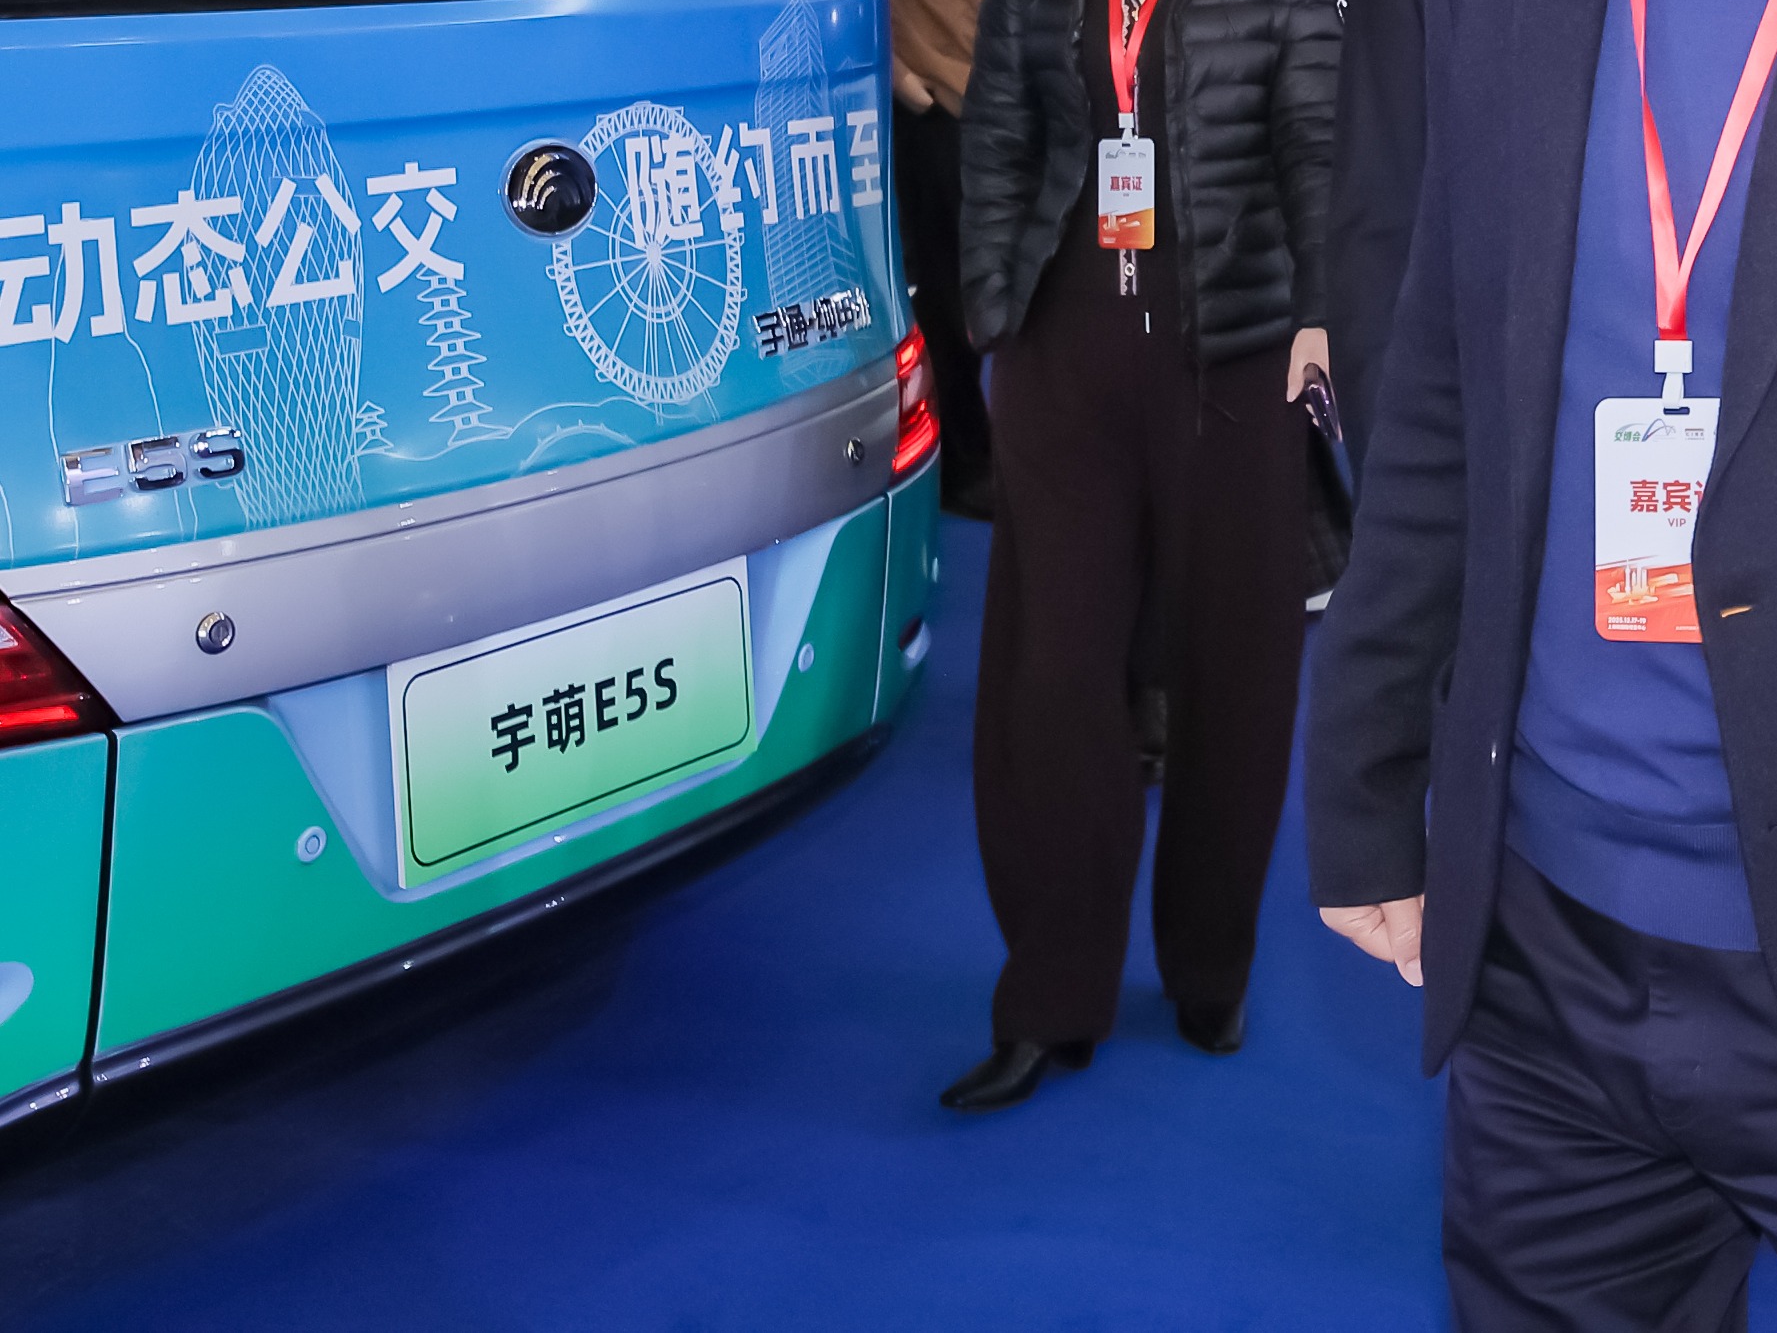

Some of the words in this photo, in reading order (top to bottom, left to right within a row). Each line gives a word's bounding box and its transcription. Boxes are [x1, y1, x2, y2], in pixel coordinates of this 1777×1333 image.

[624, 109, 883, 248] 随约而至
[1110, 175, 1143, 191] 嘉宾证
[0, 161, 466, 347] 动态公交
[60, 427, 245, 507] E5S
[1667, 517, 1687, 528] VIP
[489, 657, 681, 774] 宇萌E5S
